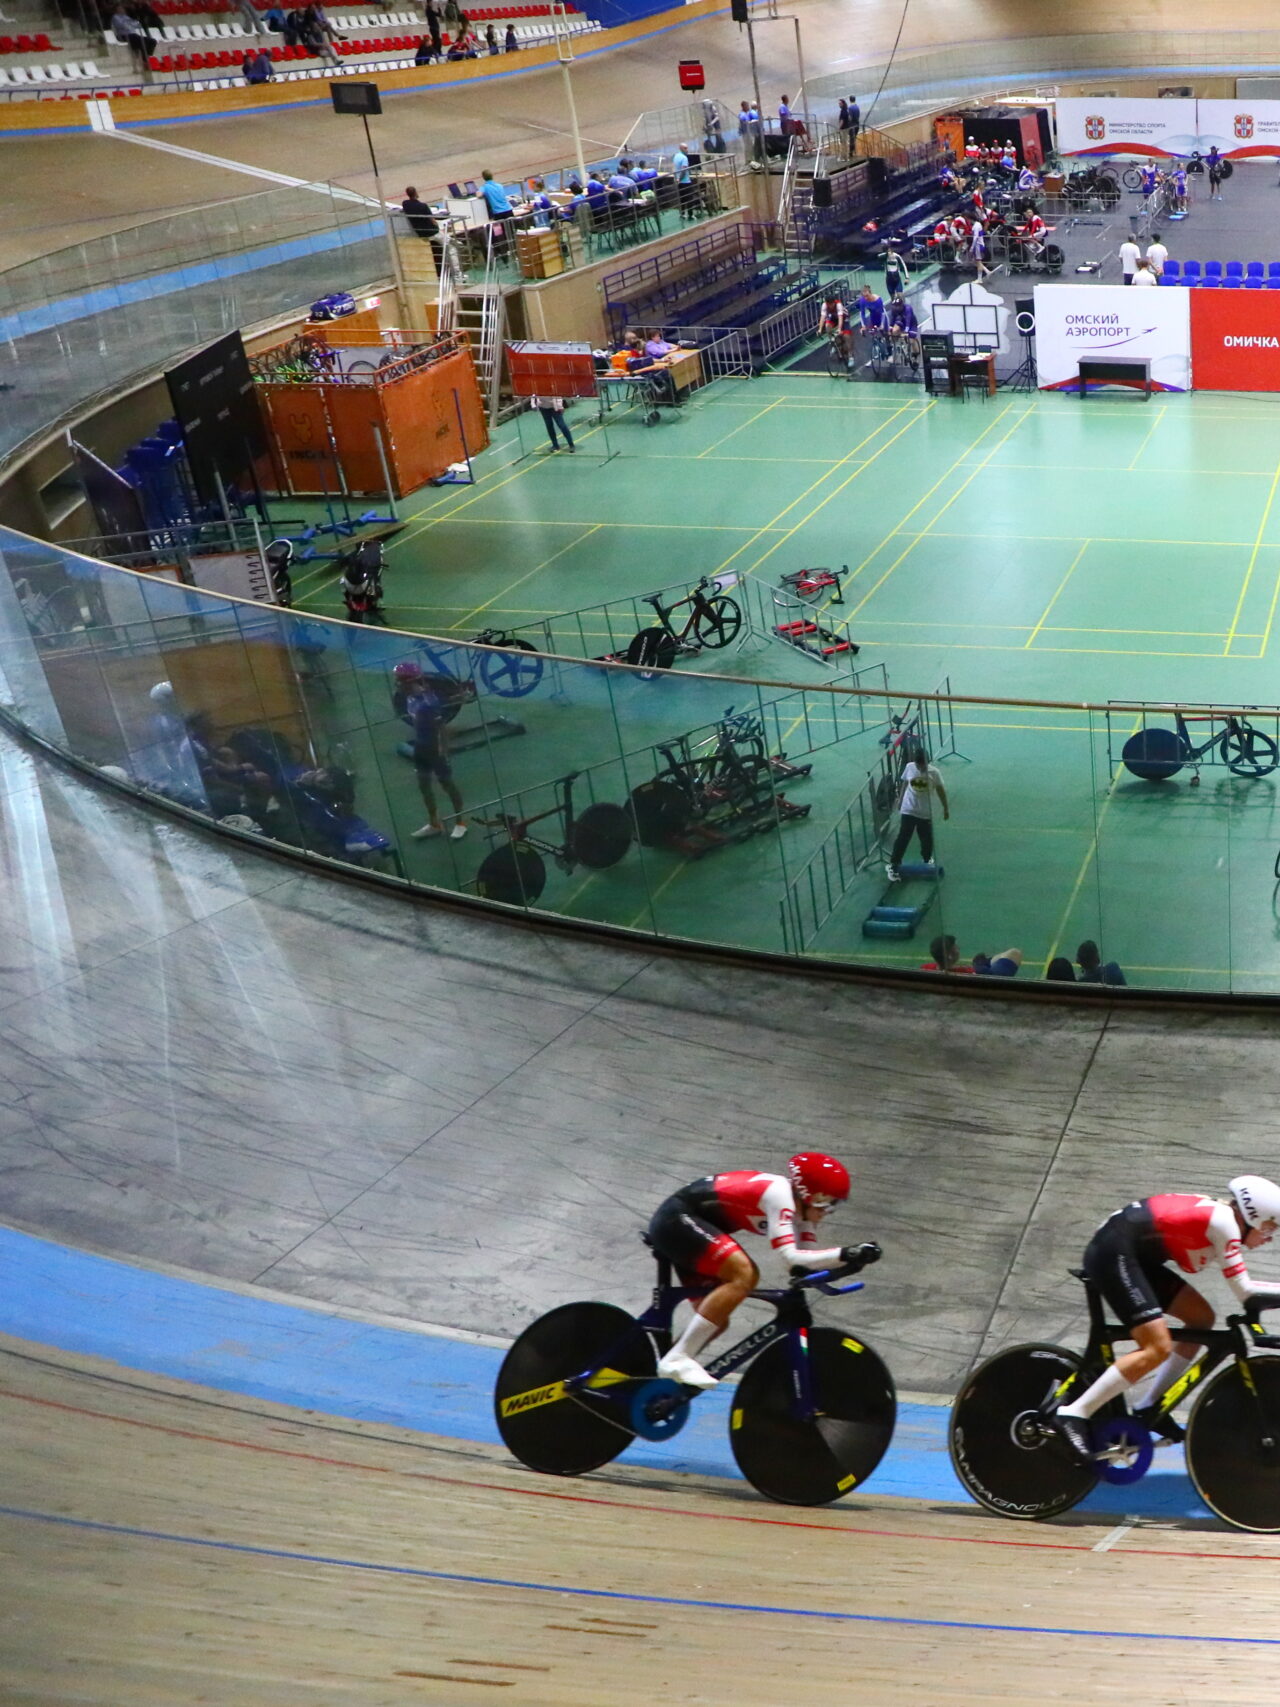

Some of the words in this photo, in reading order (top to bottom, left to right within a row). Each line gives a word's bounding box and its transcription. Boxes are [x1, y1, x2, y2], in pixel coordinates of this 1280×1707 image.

[1065, 313, 1119, 325] ОМСКИЙ
[1065, 327, 1131, 337] АЭРОПОРТ
[1223, 335, 1280, 348] ОМИЧКА
[505, 1386, 556, 1414] MAVIC
